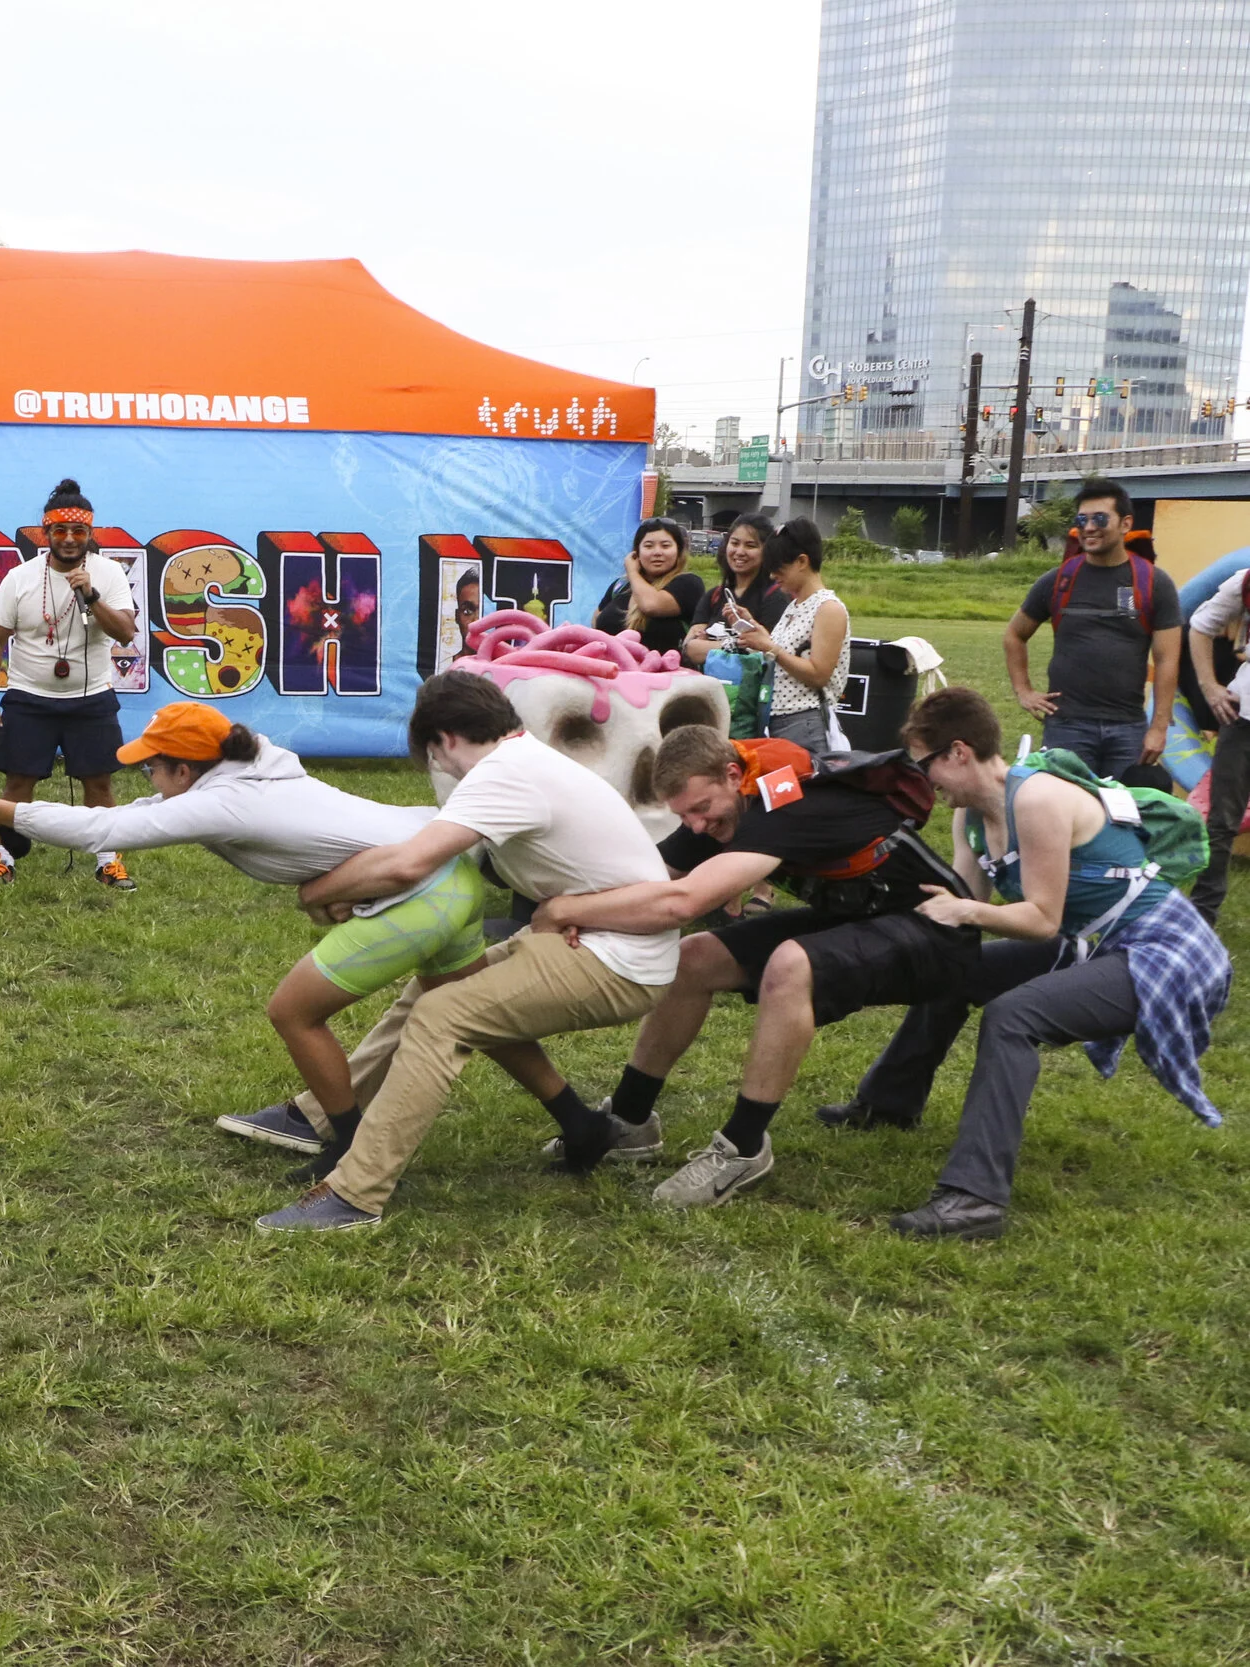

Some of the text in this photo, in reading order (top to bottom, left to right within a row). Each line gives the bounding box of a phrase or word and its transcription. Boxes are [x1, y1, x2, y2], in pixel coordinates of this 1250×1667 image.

[848, 358, 930, 372] ROBERTS CENTER
[14, 389, 310, 424] @TRUTHORANGE
[477, 396, 617, 436] truth
[417, 533, 574, 683] IT
